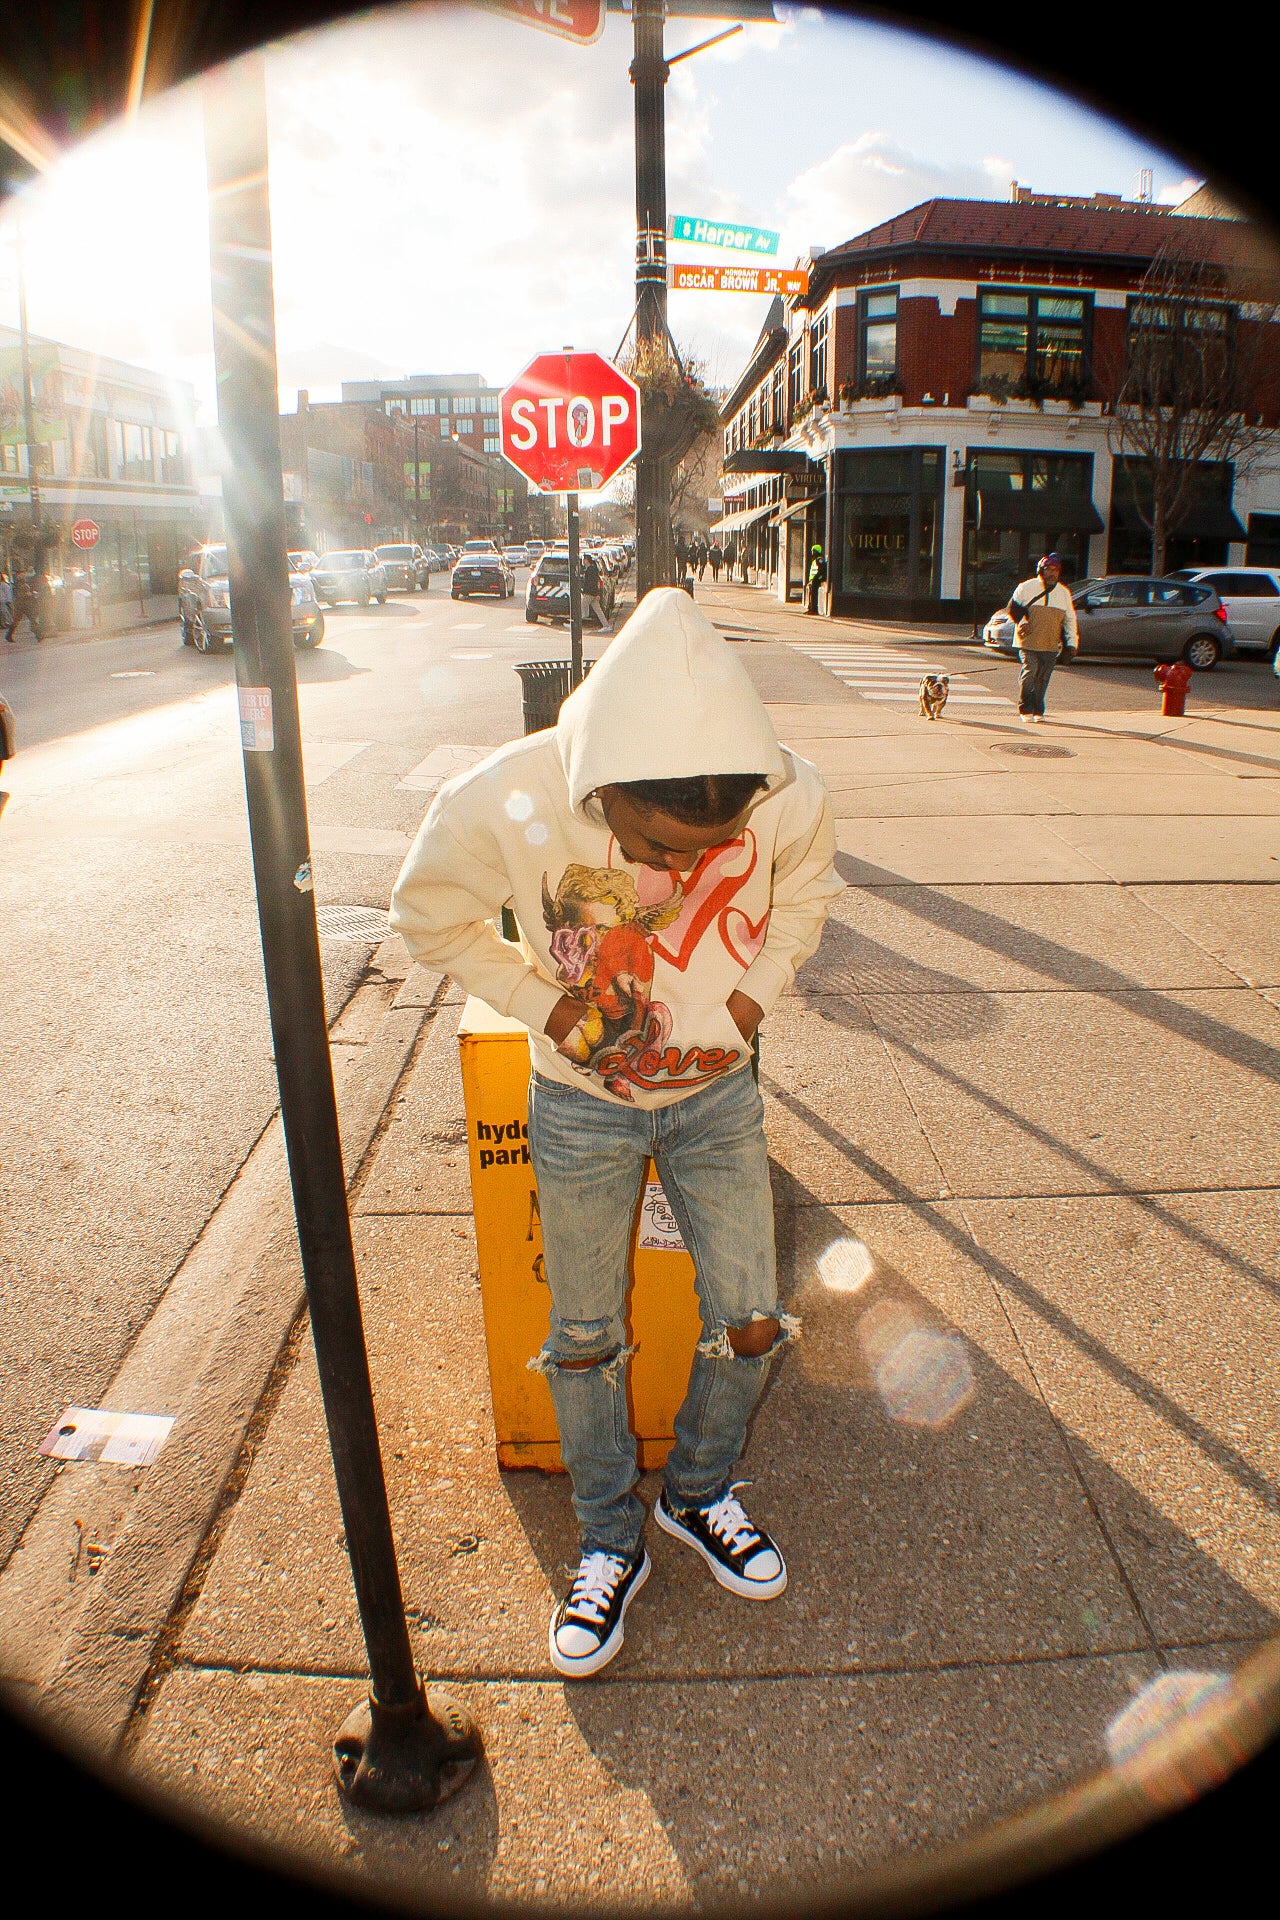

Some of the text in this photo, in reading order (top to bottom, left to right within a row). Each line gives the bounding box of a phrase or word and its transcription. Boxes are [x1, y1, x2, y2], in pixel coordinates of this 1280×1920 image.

[694, 221, 752, 249] Harper
[755, 234, 771, 249] Av
[679, 273, 802, 293] OSCAR BROWN JR. WAY
[510, 395, 630, 451] STOP
[795, 473, 824, 484] VIRTUE
[74, 528, 98, 541] STOP
[847, 534, 905, 549] VIRTUE
[257, 694, 270, 708] TO
